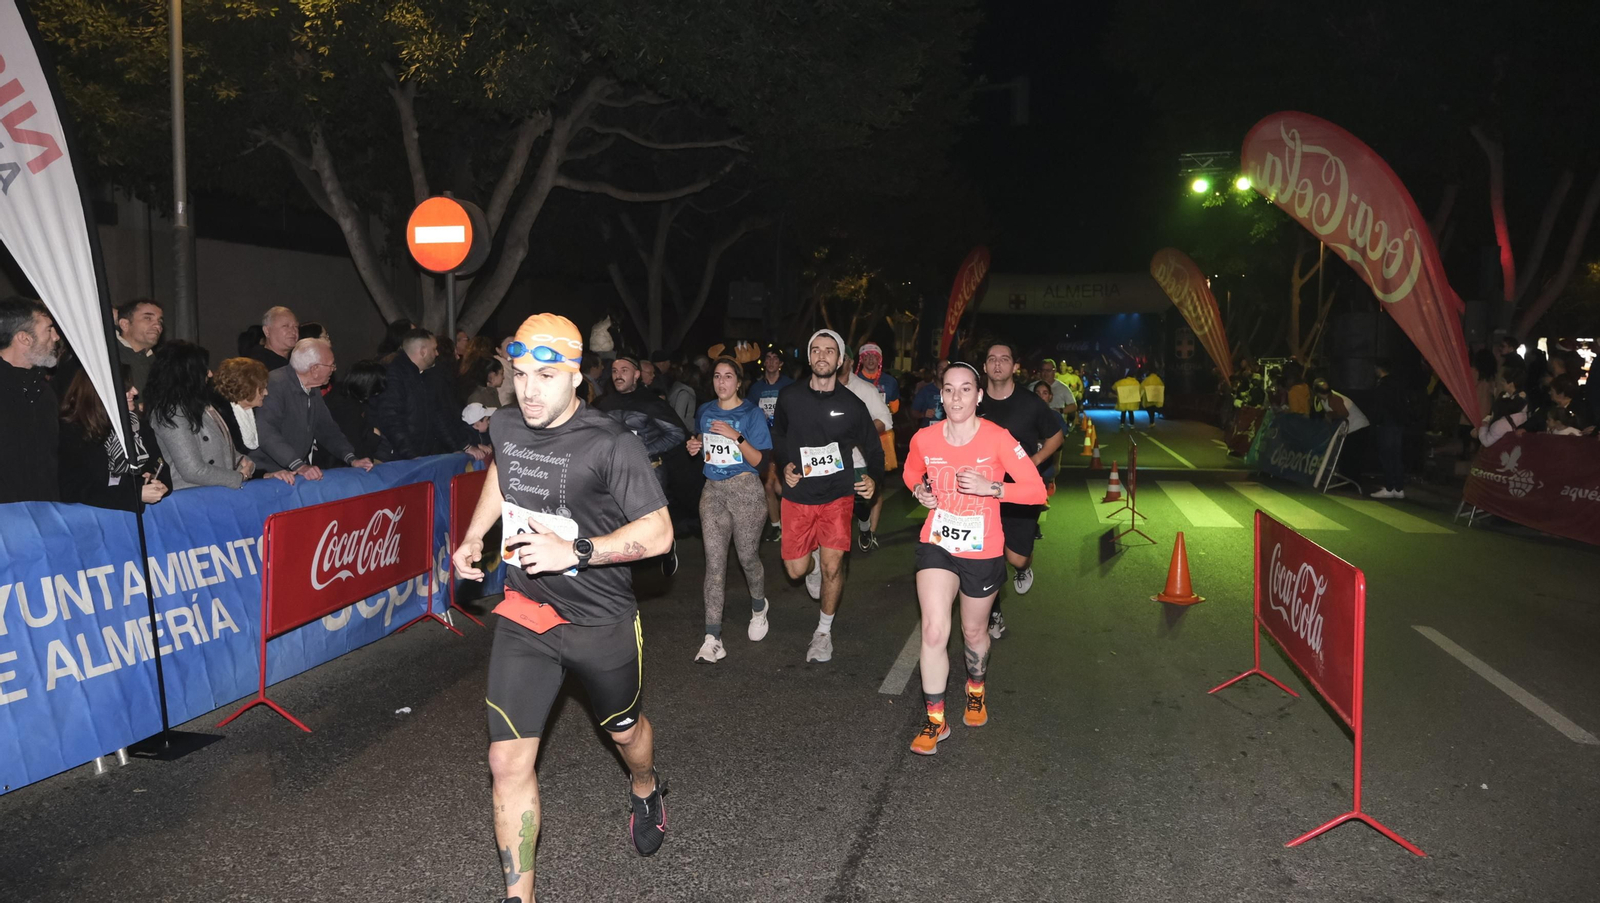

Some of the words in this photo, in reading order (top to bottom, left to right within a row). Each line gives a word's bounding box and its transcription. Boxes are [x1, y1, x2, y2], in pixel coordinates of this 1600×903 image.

[502, 441, 565, 465] Mediterráneo
[710, 445, 730, 454] 791
[811, 455, 833, 466] 843
[508, 460, 549, 479] Popular
[508, 477, 550, 500] Running
[942, 525, 971, 541] 857
[311, 505, 406, 590] Coca-Cola
[1269, 543, 1328, 654] Coca-Cola
[47, 593, 240, 691] ALMERÍA
